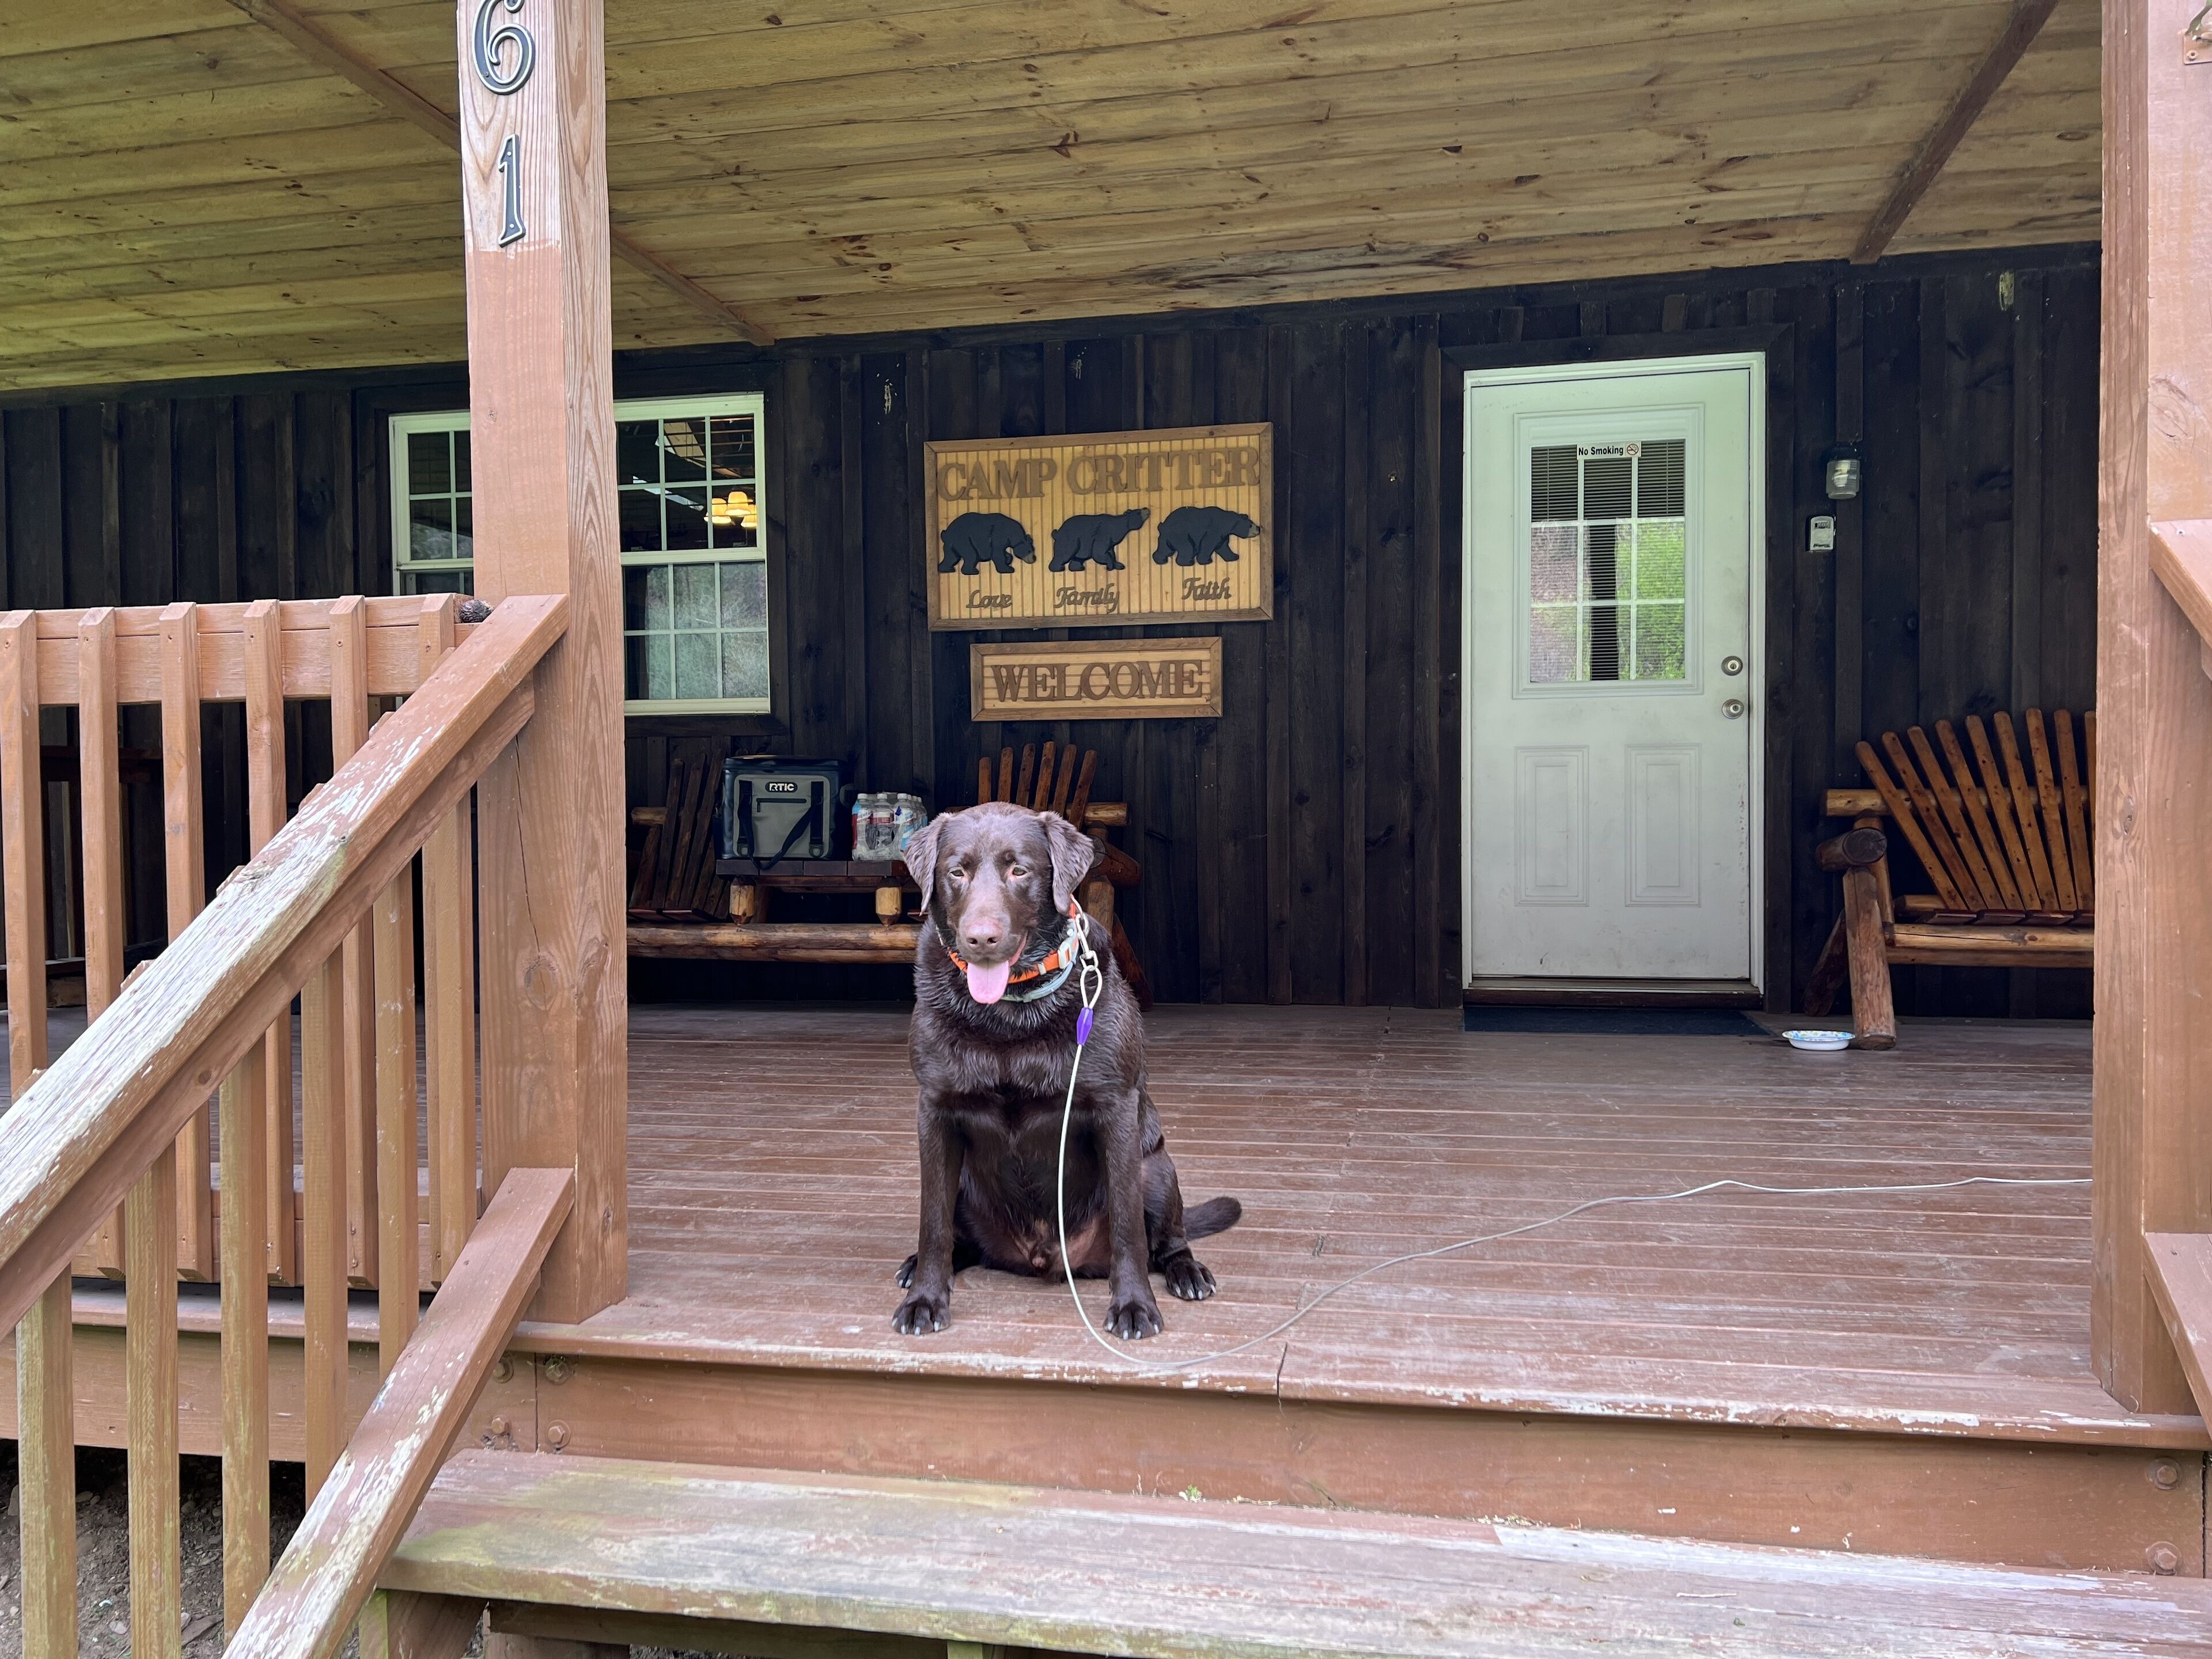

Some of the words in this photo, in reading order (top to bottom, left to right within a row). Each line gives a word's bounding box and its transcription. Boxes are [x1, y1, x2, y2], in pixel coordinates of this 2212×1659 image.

[1578, 447, 1588, 456] No
[1590, 445, 1624, 456] Smoking
[937, 457, 1058, 502] CAMP
[1067, 446, 1261, 495] CRITTER
[966, 590, 1013, 609] Love
[1053, 582, 1120, 613] Family
[1181, 577, 1232, 601] Faith
[990, 659, 1203, 702] WELCOME
[769, 783, 795, 791] RTIC
